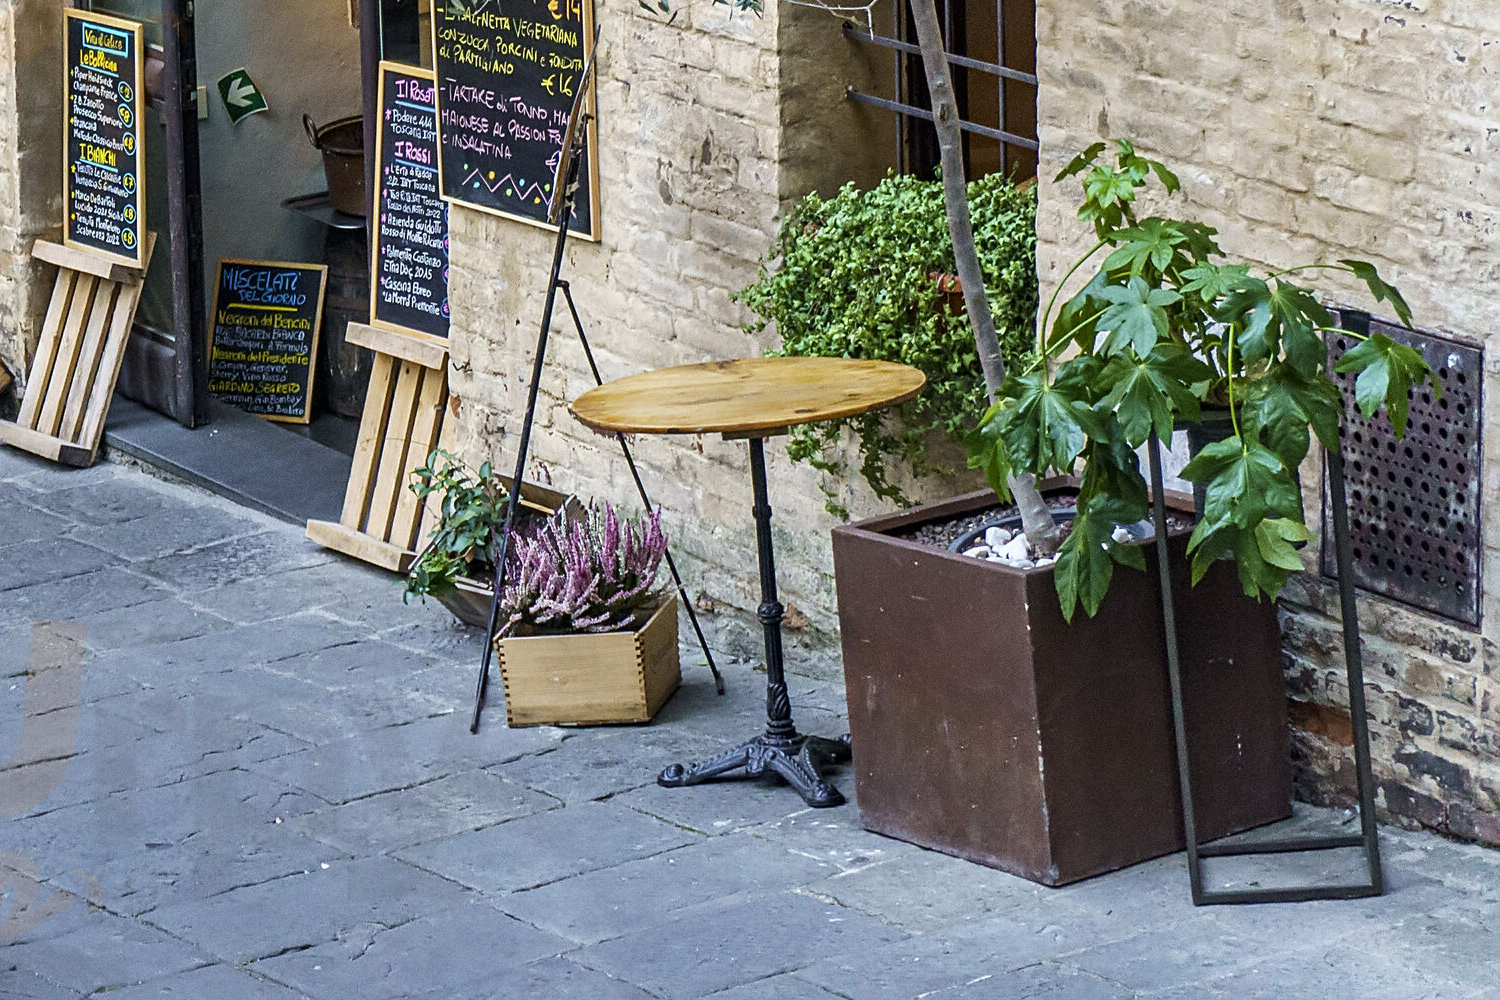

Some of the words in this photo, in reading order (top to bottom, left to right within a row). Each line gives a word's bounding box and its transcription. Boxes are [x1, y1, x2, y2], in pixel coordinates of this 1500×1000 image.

[513, 18, 578, 48] VEGETARIANA
[495, 36, 538, 63] PORCINI
[540, 73, 573, 97] €16
[441, 109, 489, 133] MAIONESE
[493, 122, 505, 138] AL
[508, 119, 546, 141] PASSION
[452, 134, 512, 160] INSALATINA
